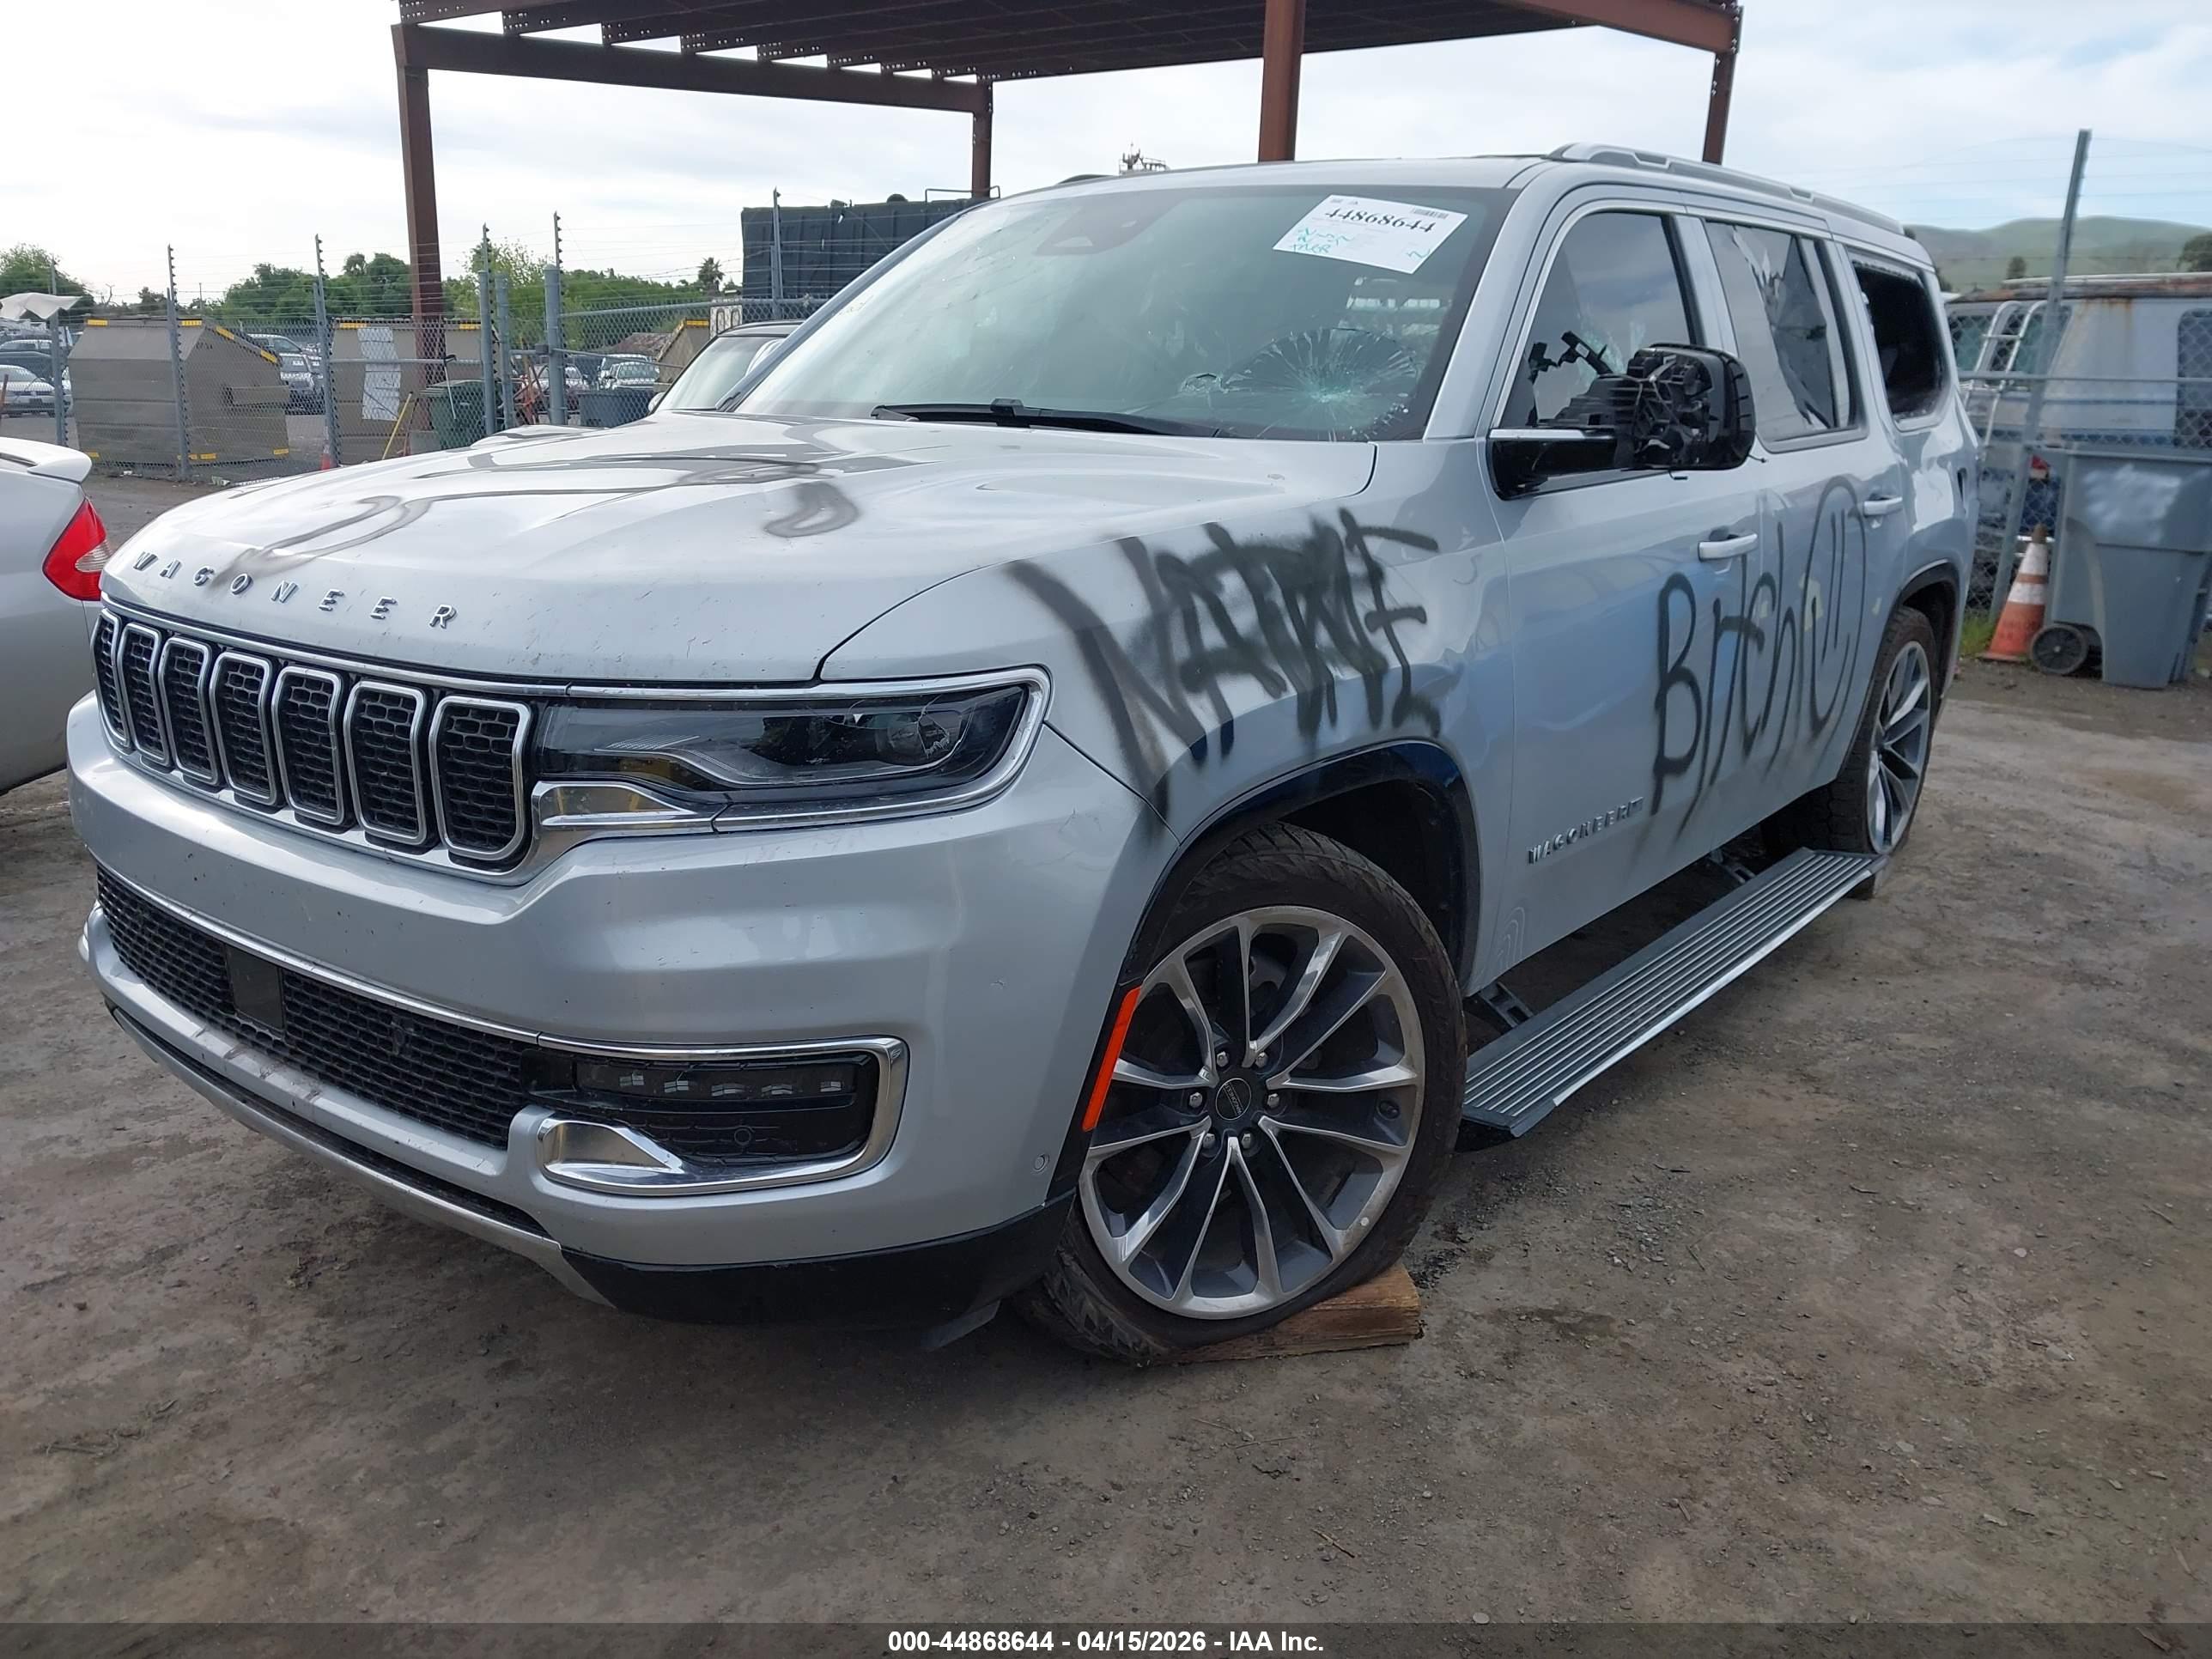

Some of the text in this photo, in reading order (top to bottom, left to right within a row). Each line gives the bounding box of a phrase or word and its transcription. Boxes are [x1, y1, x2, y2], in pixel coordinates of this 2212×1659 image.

[1325, 208, 1437, 233] 44868644
[132, 551, 458, 629] WAGONEER
[1528, 805, 1630, 864] WAGONEER
